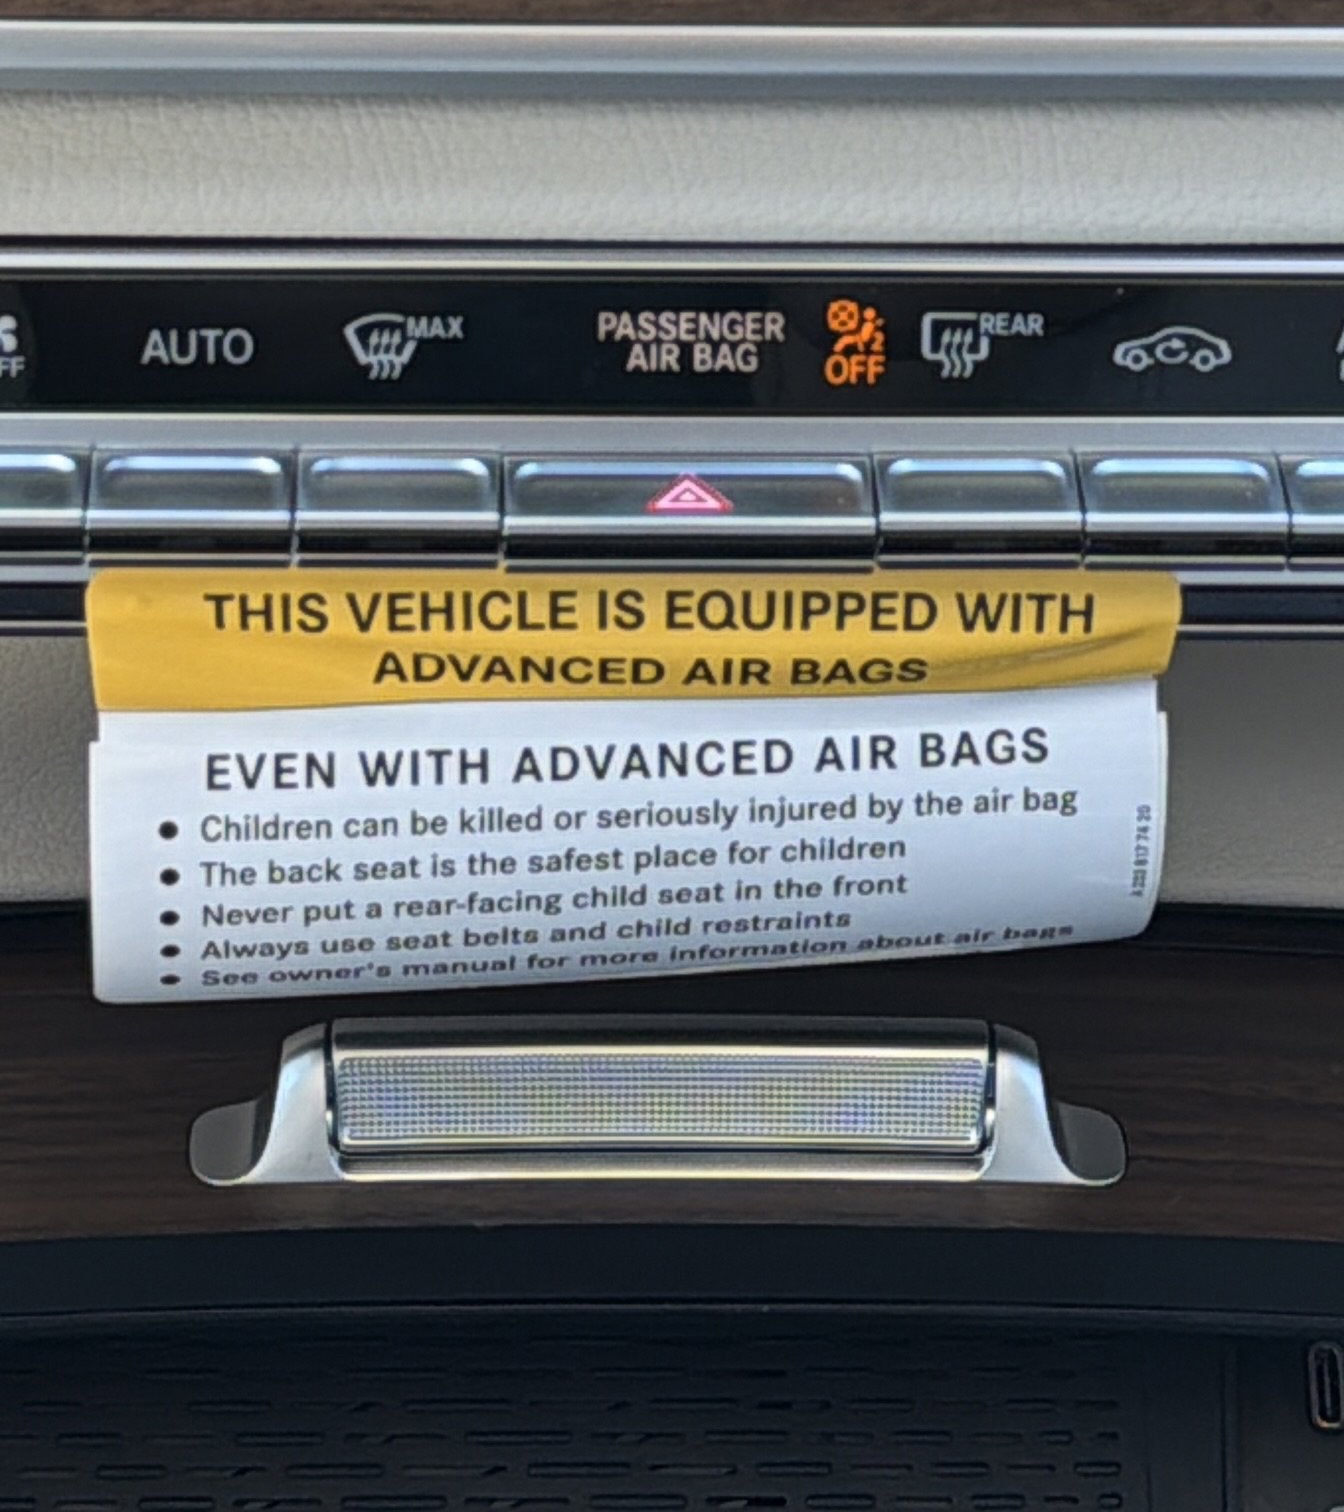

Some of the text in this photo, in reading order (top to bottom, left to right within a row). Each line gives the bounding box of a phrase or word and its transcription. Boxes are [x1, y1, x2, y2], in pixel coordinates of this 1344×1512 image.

[406, 316, 464, 339] MAX
[598, 311, 785, 342] PASSENGER
[979, 312, 1044, 337] REAR
[141, 327, 254, 365] AUTO
[626, 341, 758, 373] AIR BAG
[824, 354, 885, 385] OFF
[203, 588, 1095, 635] THIS VEHICLE IS EQUIPPED WITH
[373, 651, 929, 686] ADVANCED AIR BAGS
[206, 726, 1049, 791] EVEN WITH ADVANCED AIR BAGS
[200, 786, 1078, 843] Children can be killed or seriously injured by the air bag
[199, 836, 906, 888] The back seat is the safest place for children
[202, 874, 907, 928] Never put a rear-facing child seat in the front
[200, 911, 851, 962] Always use seat belts and child restraints
[201, 924, 1073, 987] See owner's manual for more information about air bags
